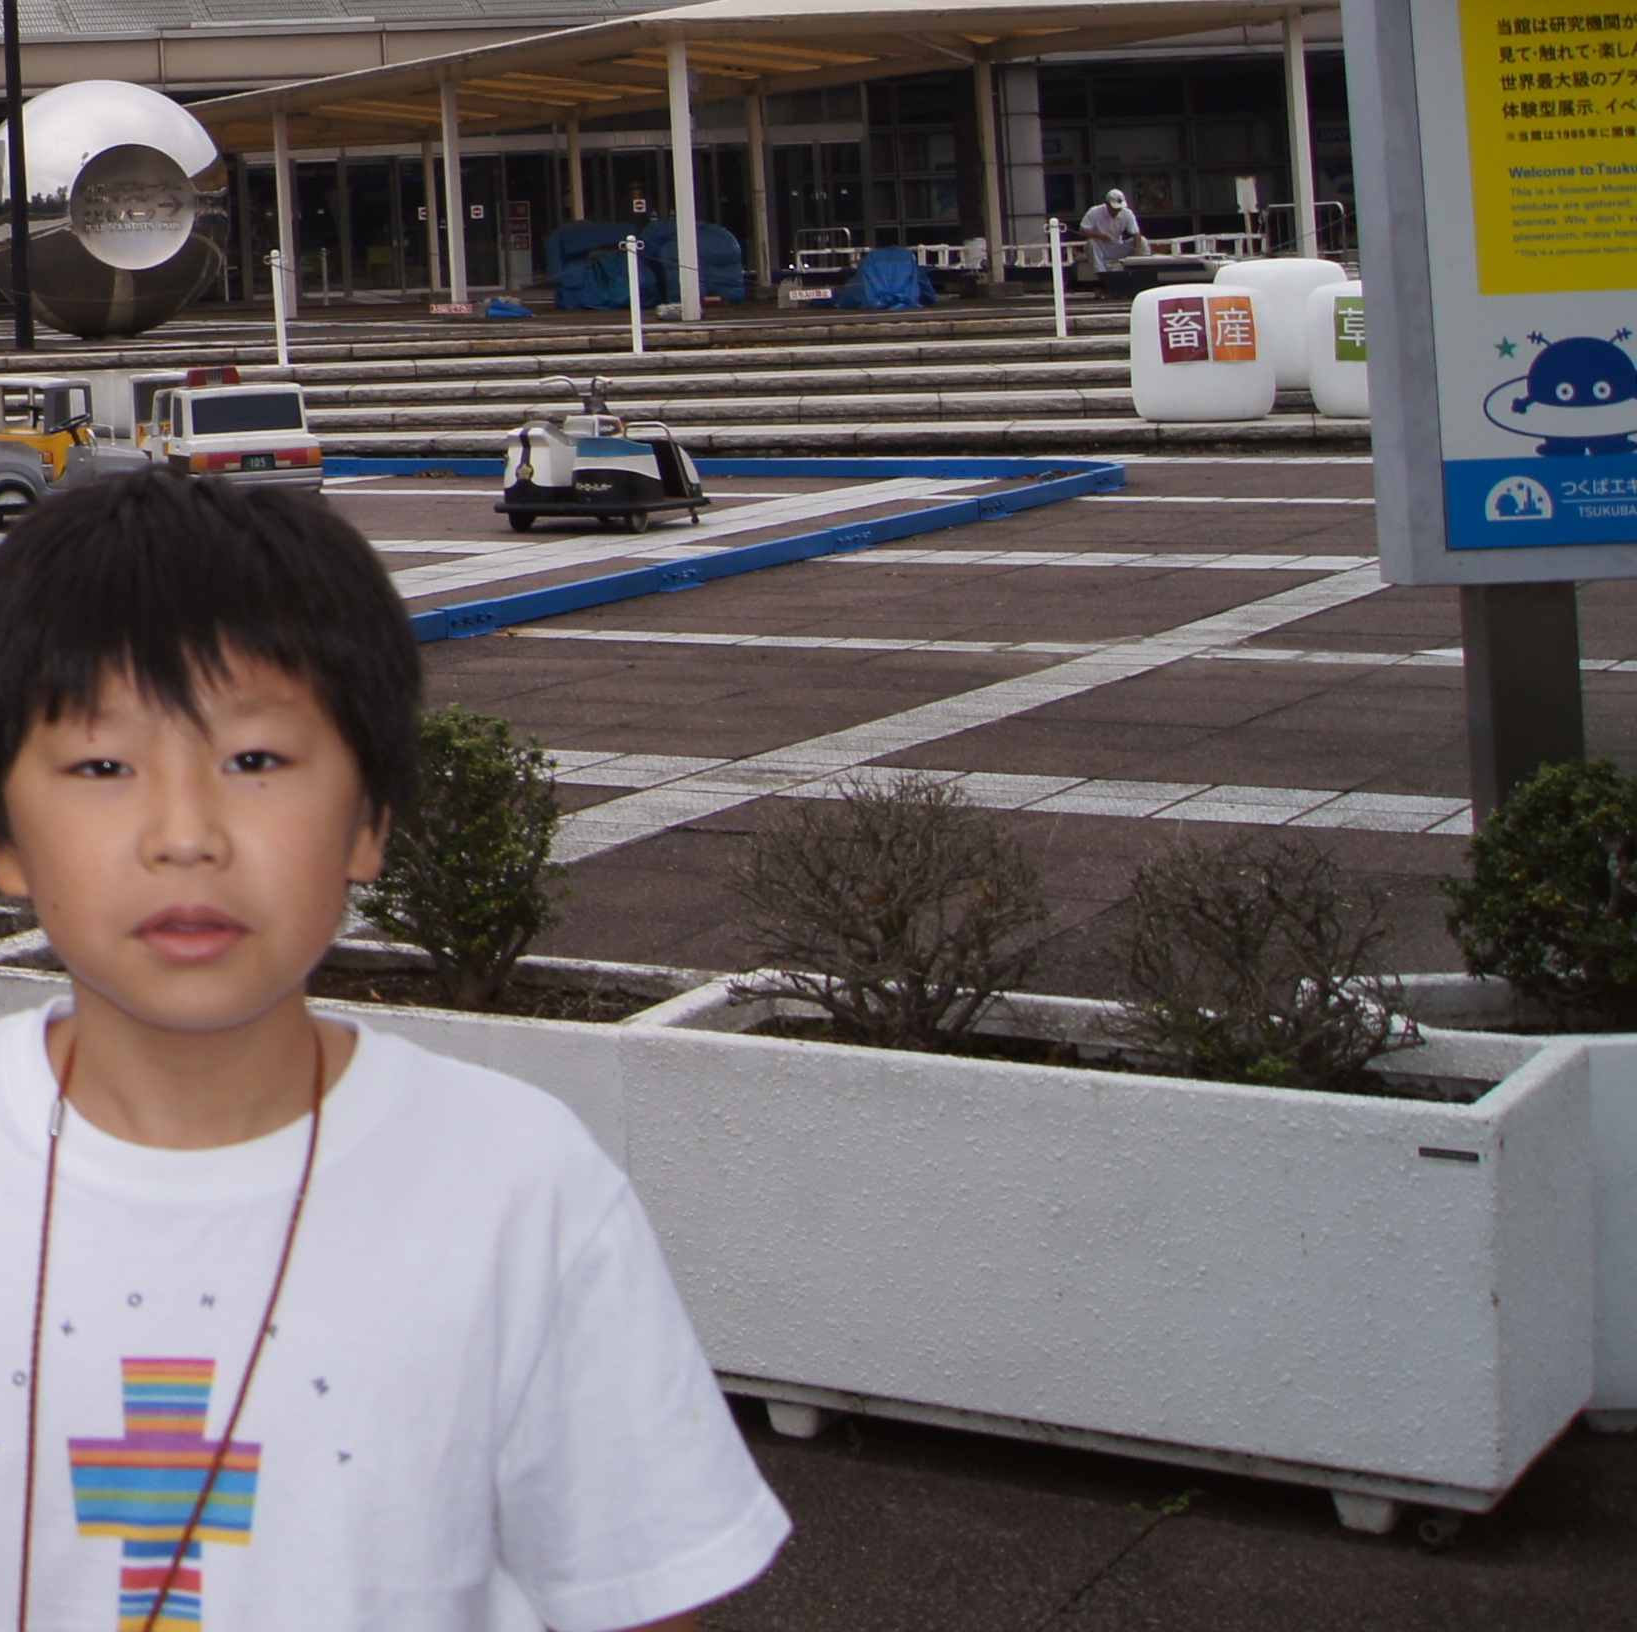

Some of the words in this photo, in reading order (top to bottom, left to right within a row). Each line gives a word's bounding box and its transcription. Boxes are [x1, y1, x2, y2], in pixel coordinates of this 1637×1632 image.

[1509, 166, 1575, 179] Welcome
[1580, 165, 1595, 176] to
[1162, 307, 1253, 349] 畜産
[1578, 505, 1637, 518] TSUKUBA
